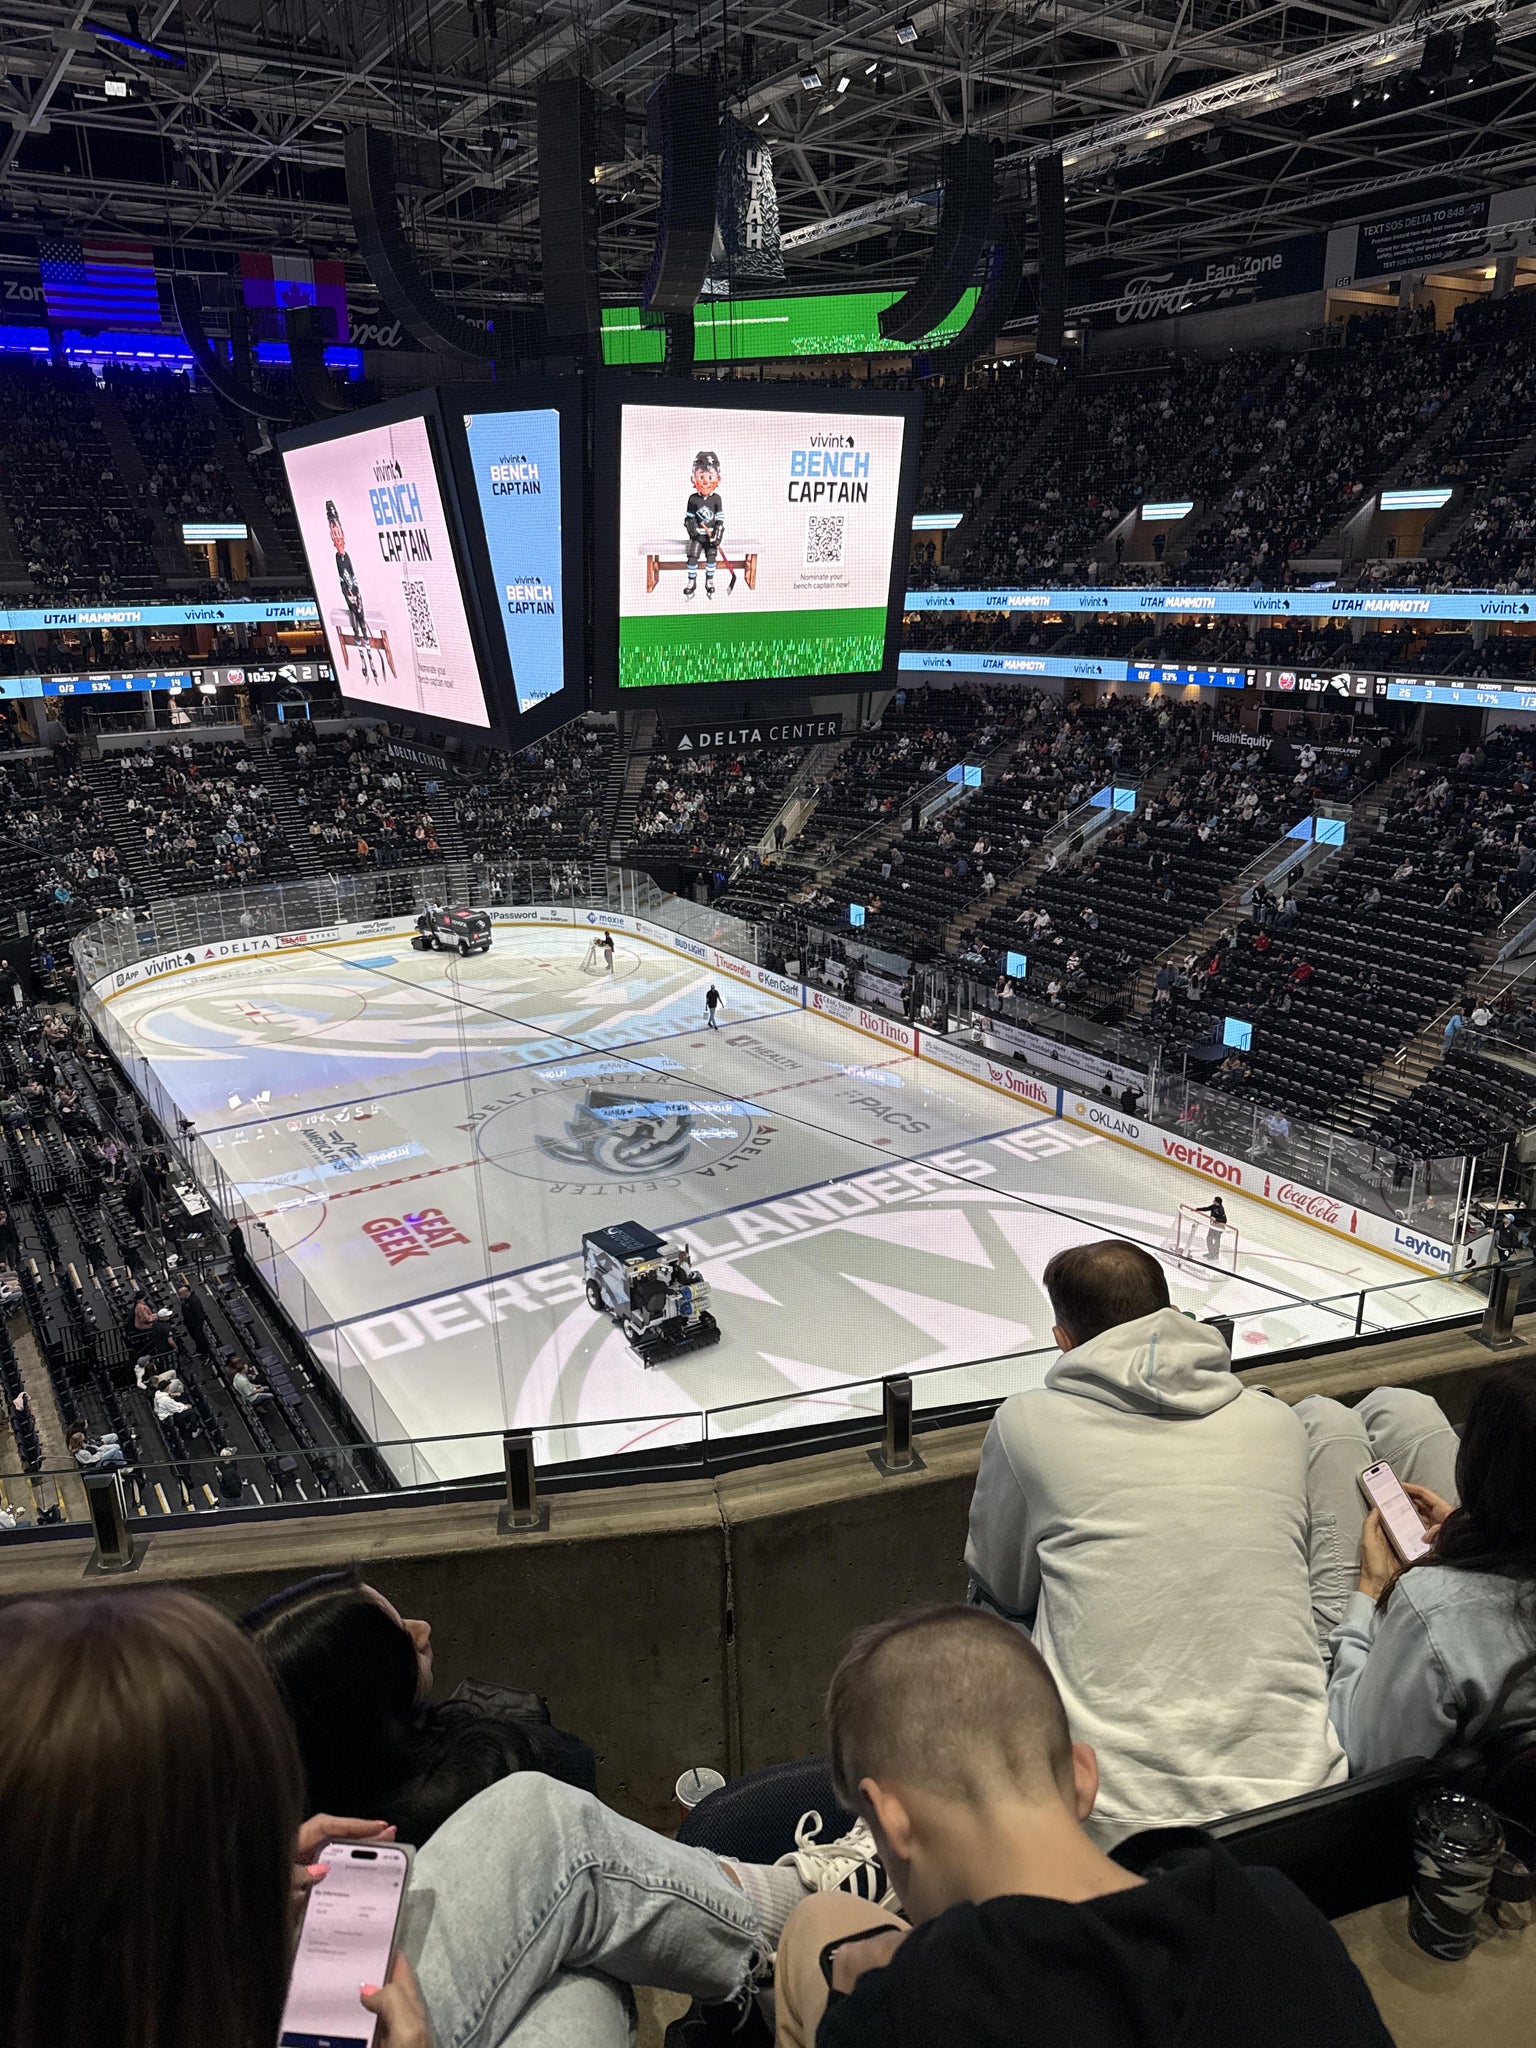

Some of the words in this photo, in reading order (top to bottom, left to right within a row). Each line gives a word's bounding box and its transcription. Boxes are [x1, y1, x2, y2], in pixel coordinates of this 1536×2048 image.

[745, 149, 763, 249] UTAH
[1364, 224, 1385, 237] TEXT
[1385, 221, 1403, 232] SOS
[1405, 214, 1431, 227] DELTA
[1433, 210, 1446, 220] TO
[3, 280, 45, 301] Zon
[1115, 272, 1194, 323] Ford
[490, 464, 539, 481] BENCH
[791, 450, 870, 478] BENCH
[492, 481, 541, 495] CAPTAIN
[788, 481, 868, 503] CAPTAIN
[369, 483, 423, 526] BENCH
[379, 529, 432, 562] CAPTAIN
[800, 573, 828, 581] Nominate
[830, 574, 843, 584] your
[813, 582, 835, 590] captain
[506, 585, 553, 600] BENCH
[508, 602, 555, 614] CAPTAIN
[987, 597, 1007, 606] UTAH
[1008, 596, 1050, 607] MAMMOTH
[1140, 597, 1165, 608] UTAH
[1165, 597, 1215, 609] MAMMOTH
[1332, 600, 1363, 611] UTAH
[1364, 600, 1430, 613] MAMMOTH
[44, 614, 76, 624] UTAH
[79, 611, 141, 623] MAMMOTH
[266, 607, 294, 617] UTAH
[302, 667, 312, 680] 2
[983, 659, 1003, 669] UTAH
[1004, 660, 1045, 671] MAMMOTH
[194, 676, 201, 685] 6
[212, 671, 220, 684] 1
[247, 671, 277, 683] 10:57
[319, 670, 330, 678] 13
[1162, 672, 1178, 682] 53%
[1188, 674, 1195, 683] 6
[1209, 675, 1215, 684] 7
[1226, 676, 1235, 685] 14
[1247, 676, 1254, 686] 6
[1265, 671, 1272, 688] 1
[58, 684, 75, 693] 0/2
[92, 682, 111, 691] 53%
[125, 681, 133, 689] 6
[151, 680, 156, 688] 7
[171, 678, 181, 687] 14
[1298, 677, 1329, 692] 10:57
[1355, 677, 1367, 694] 2
[1375, 684, 1386, 695] 13
[1398, 688, 1412, 698] 26
[1426, 689, 1432, 699] 3
[1453, 691, 1460, 701] 4
[1477, 693, 1499, 705] 47%
[700, 728, 762, 748] DELTA
[769, 721, 836, 741] CENTER
[1211, 731, 1272, 750] HealthEquity
[490, 910, 538, 920] 1Password
[599, 914, 625, 926] moxie
[280, 934, 308, 944] SME
[310, 931, 336, 940] STEEL
[356, 928, 380, 936] AMERICA
[380, 925, 396, 934] FIRST
[220, 939, 271, 956] DELTA
[675, 938, 688, 949] BUD
[687, 942, 706, 957] LIGHT
[764, 973, 779, 988] Ken
[779, 980, 799, 997] Garff
[752, 1041, 801, 1070] HEALTH
[1005, 1069, 1048, 1104] Smith's
[468, 1086, 548, 1126] DELTA
[561, 1074, 671, 1088] CENTER
[850, 1096, 931, 1134] PACS
[1089, 1108, 1139, 1139] OKLAND
[695, 1138, 772, 1177] DELTA
[1162, 1138, 1242, 1186] verizon
[550, 1177, 681, 1196] CENTER
[658, 1149, 997, 1262] LANDERS
[1277, 1183, 1343, 1224] Coca-Cola
[402, 1208, 472, 1249] SEAT
[361, 1217, 431, 1267] GEEK
[1394, 1226, 1451, 1264] Layton
